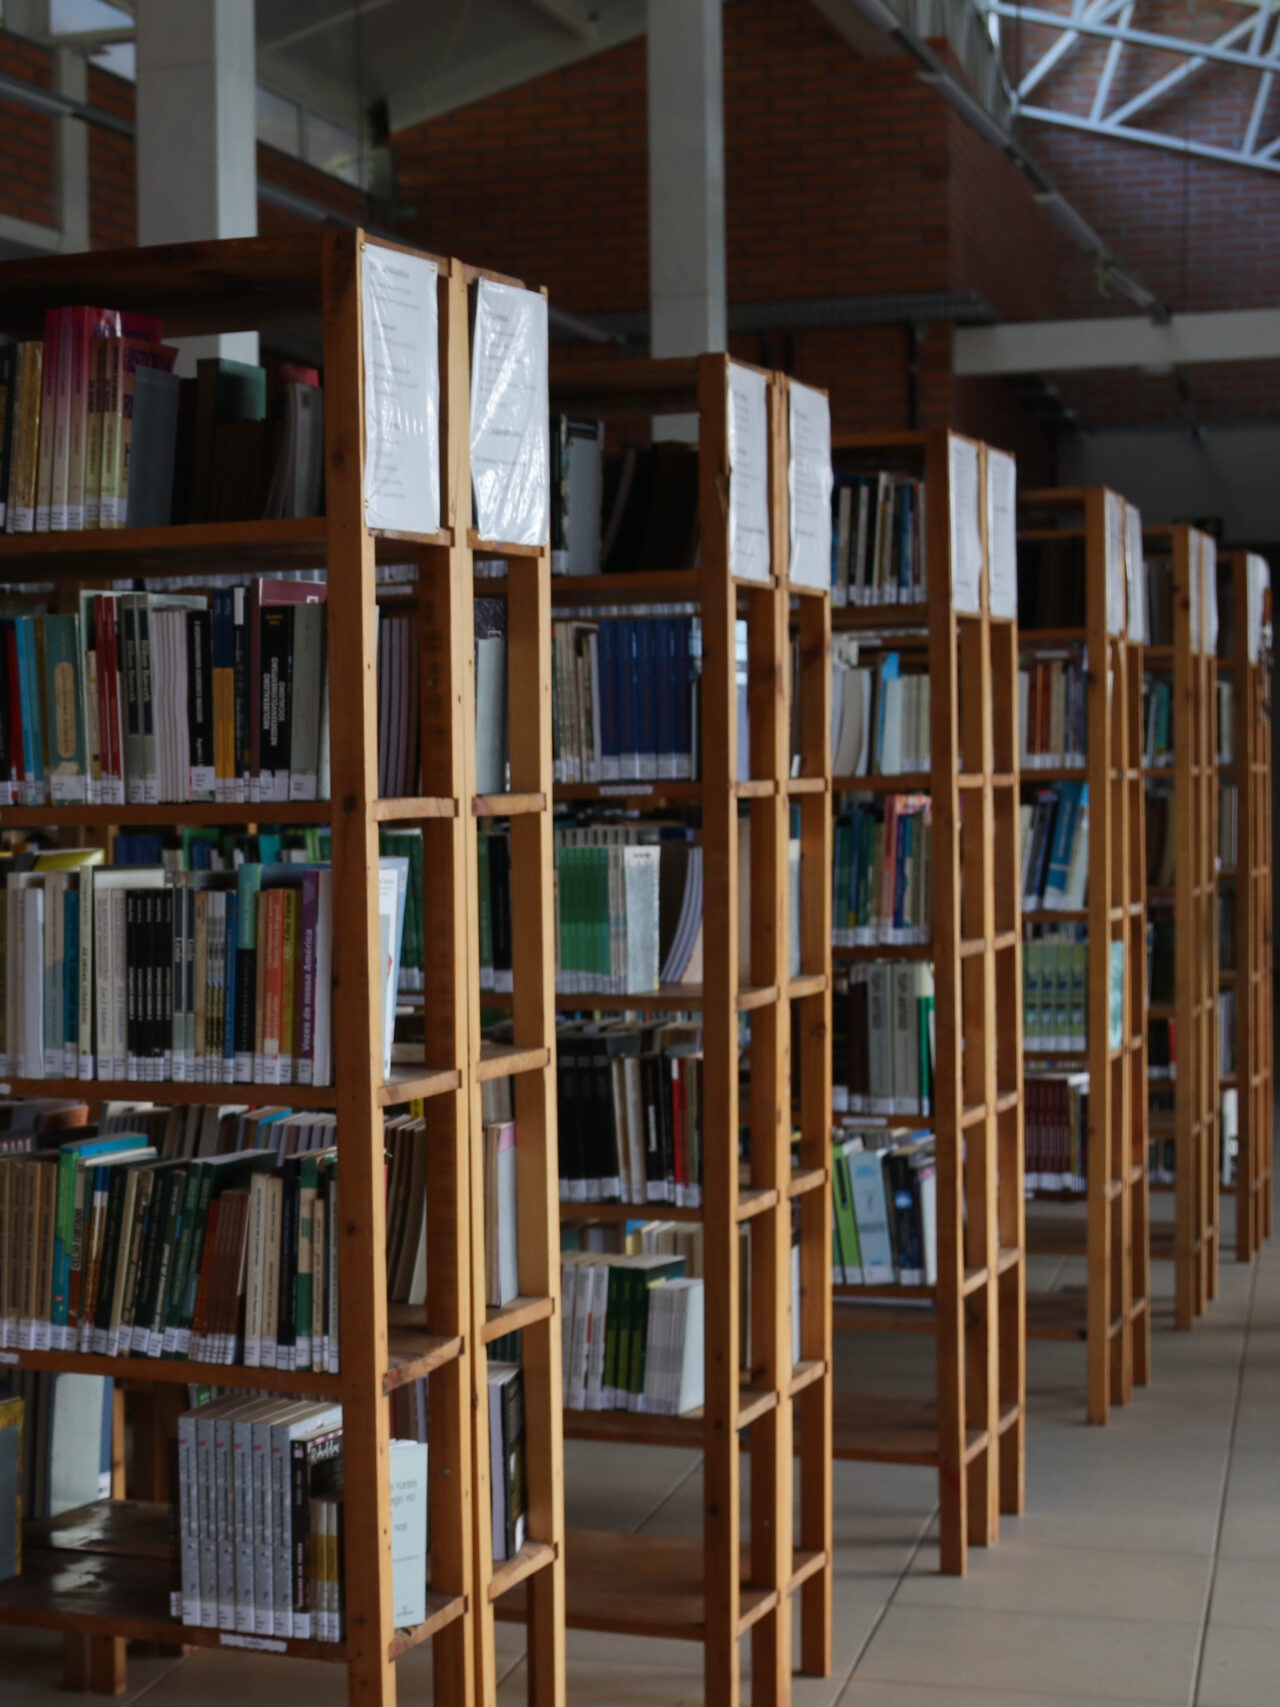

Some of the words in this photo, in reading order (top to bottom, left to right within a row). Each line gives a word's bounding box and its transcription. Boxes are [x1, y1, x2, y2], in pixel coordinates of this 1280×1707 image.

[302, 927, 313, 972] América
[303, 973, 312, 1004] nossa
[301, 1006, 312, 1020] de
[301, 1021, 311, 1052] Vozes
